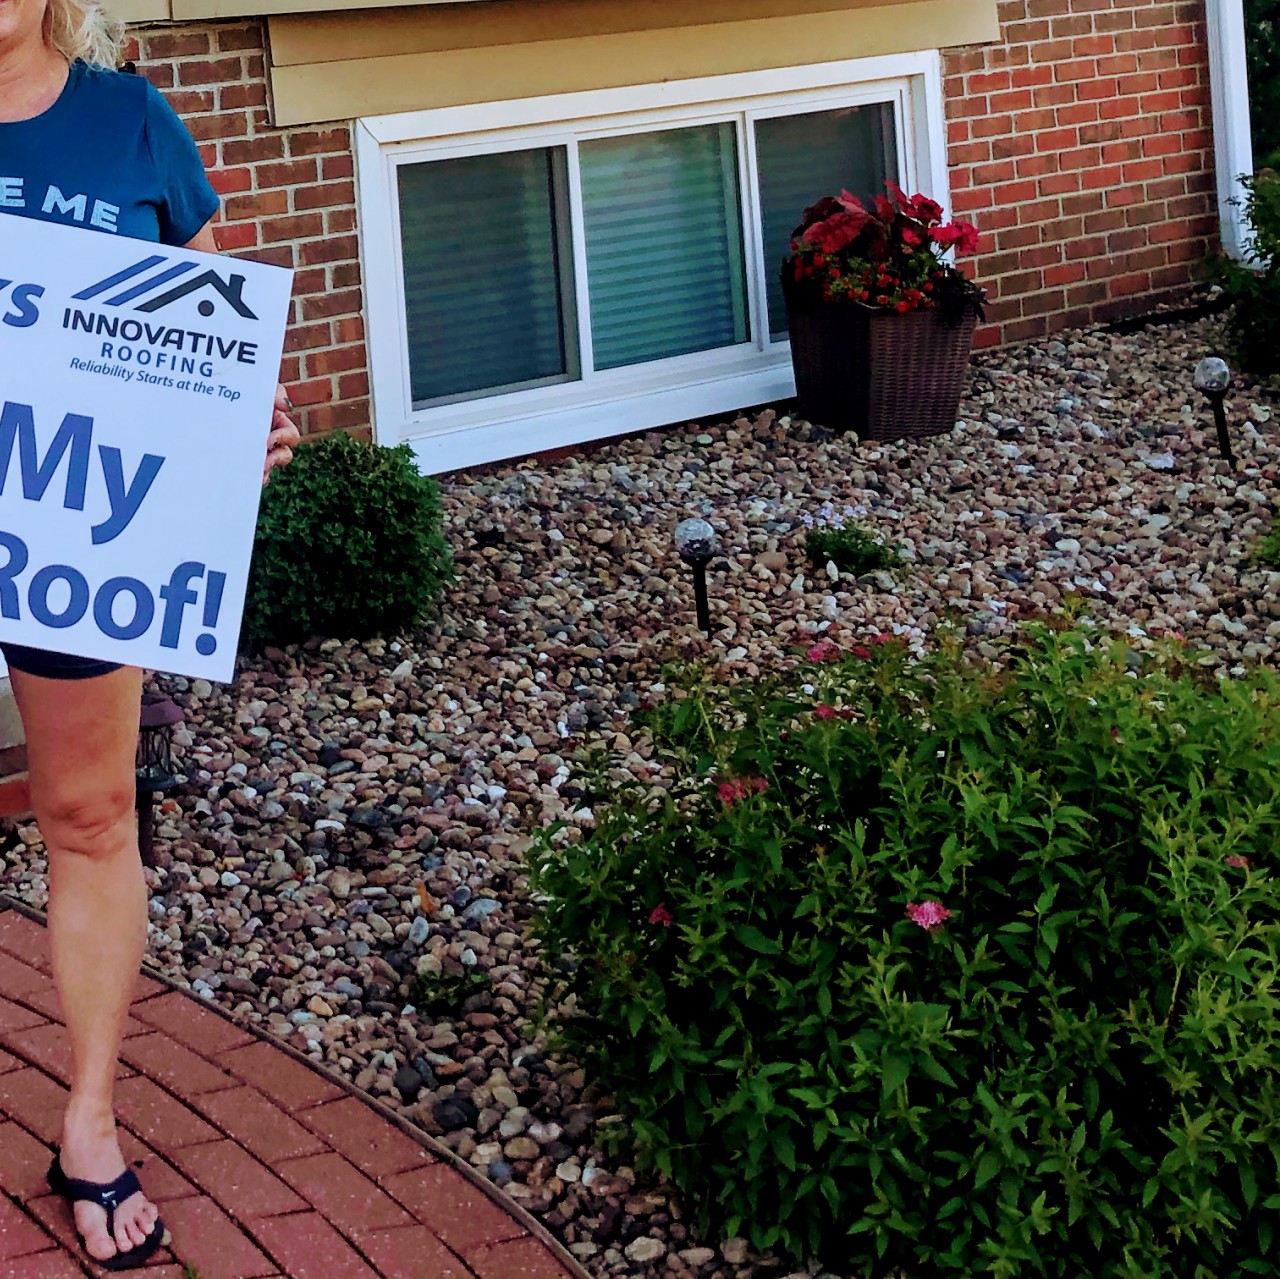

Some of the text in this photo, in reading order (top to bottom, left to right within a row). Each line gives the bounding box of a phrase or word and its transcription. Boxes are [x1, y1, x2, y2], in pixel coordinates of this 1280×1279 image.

[41, 185, 120, 233] ME
[62, 308, 258, 365] INNOVATIVE
[70, 357, 241, 402] Reliability Starts at the Top
[100, 342, 214, 378] ROOFING
